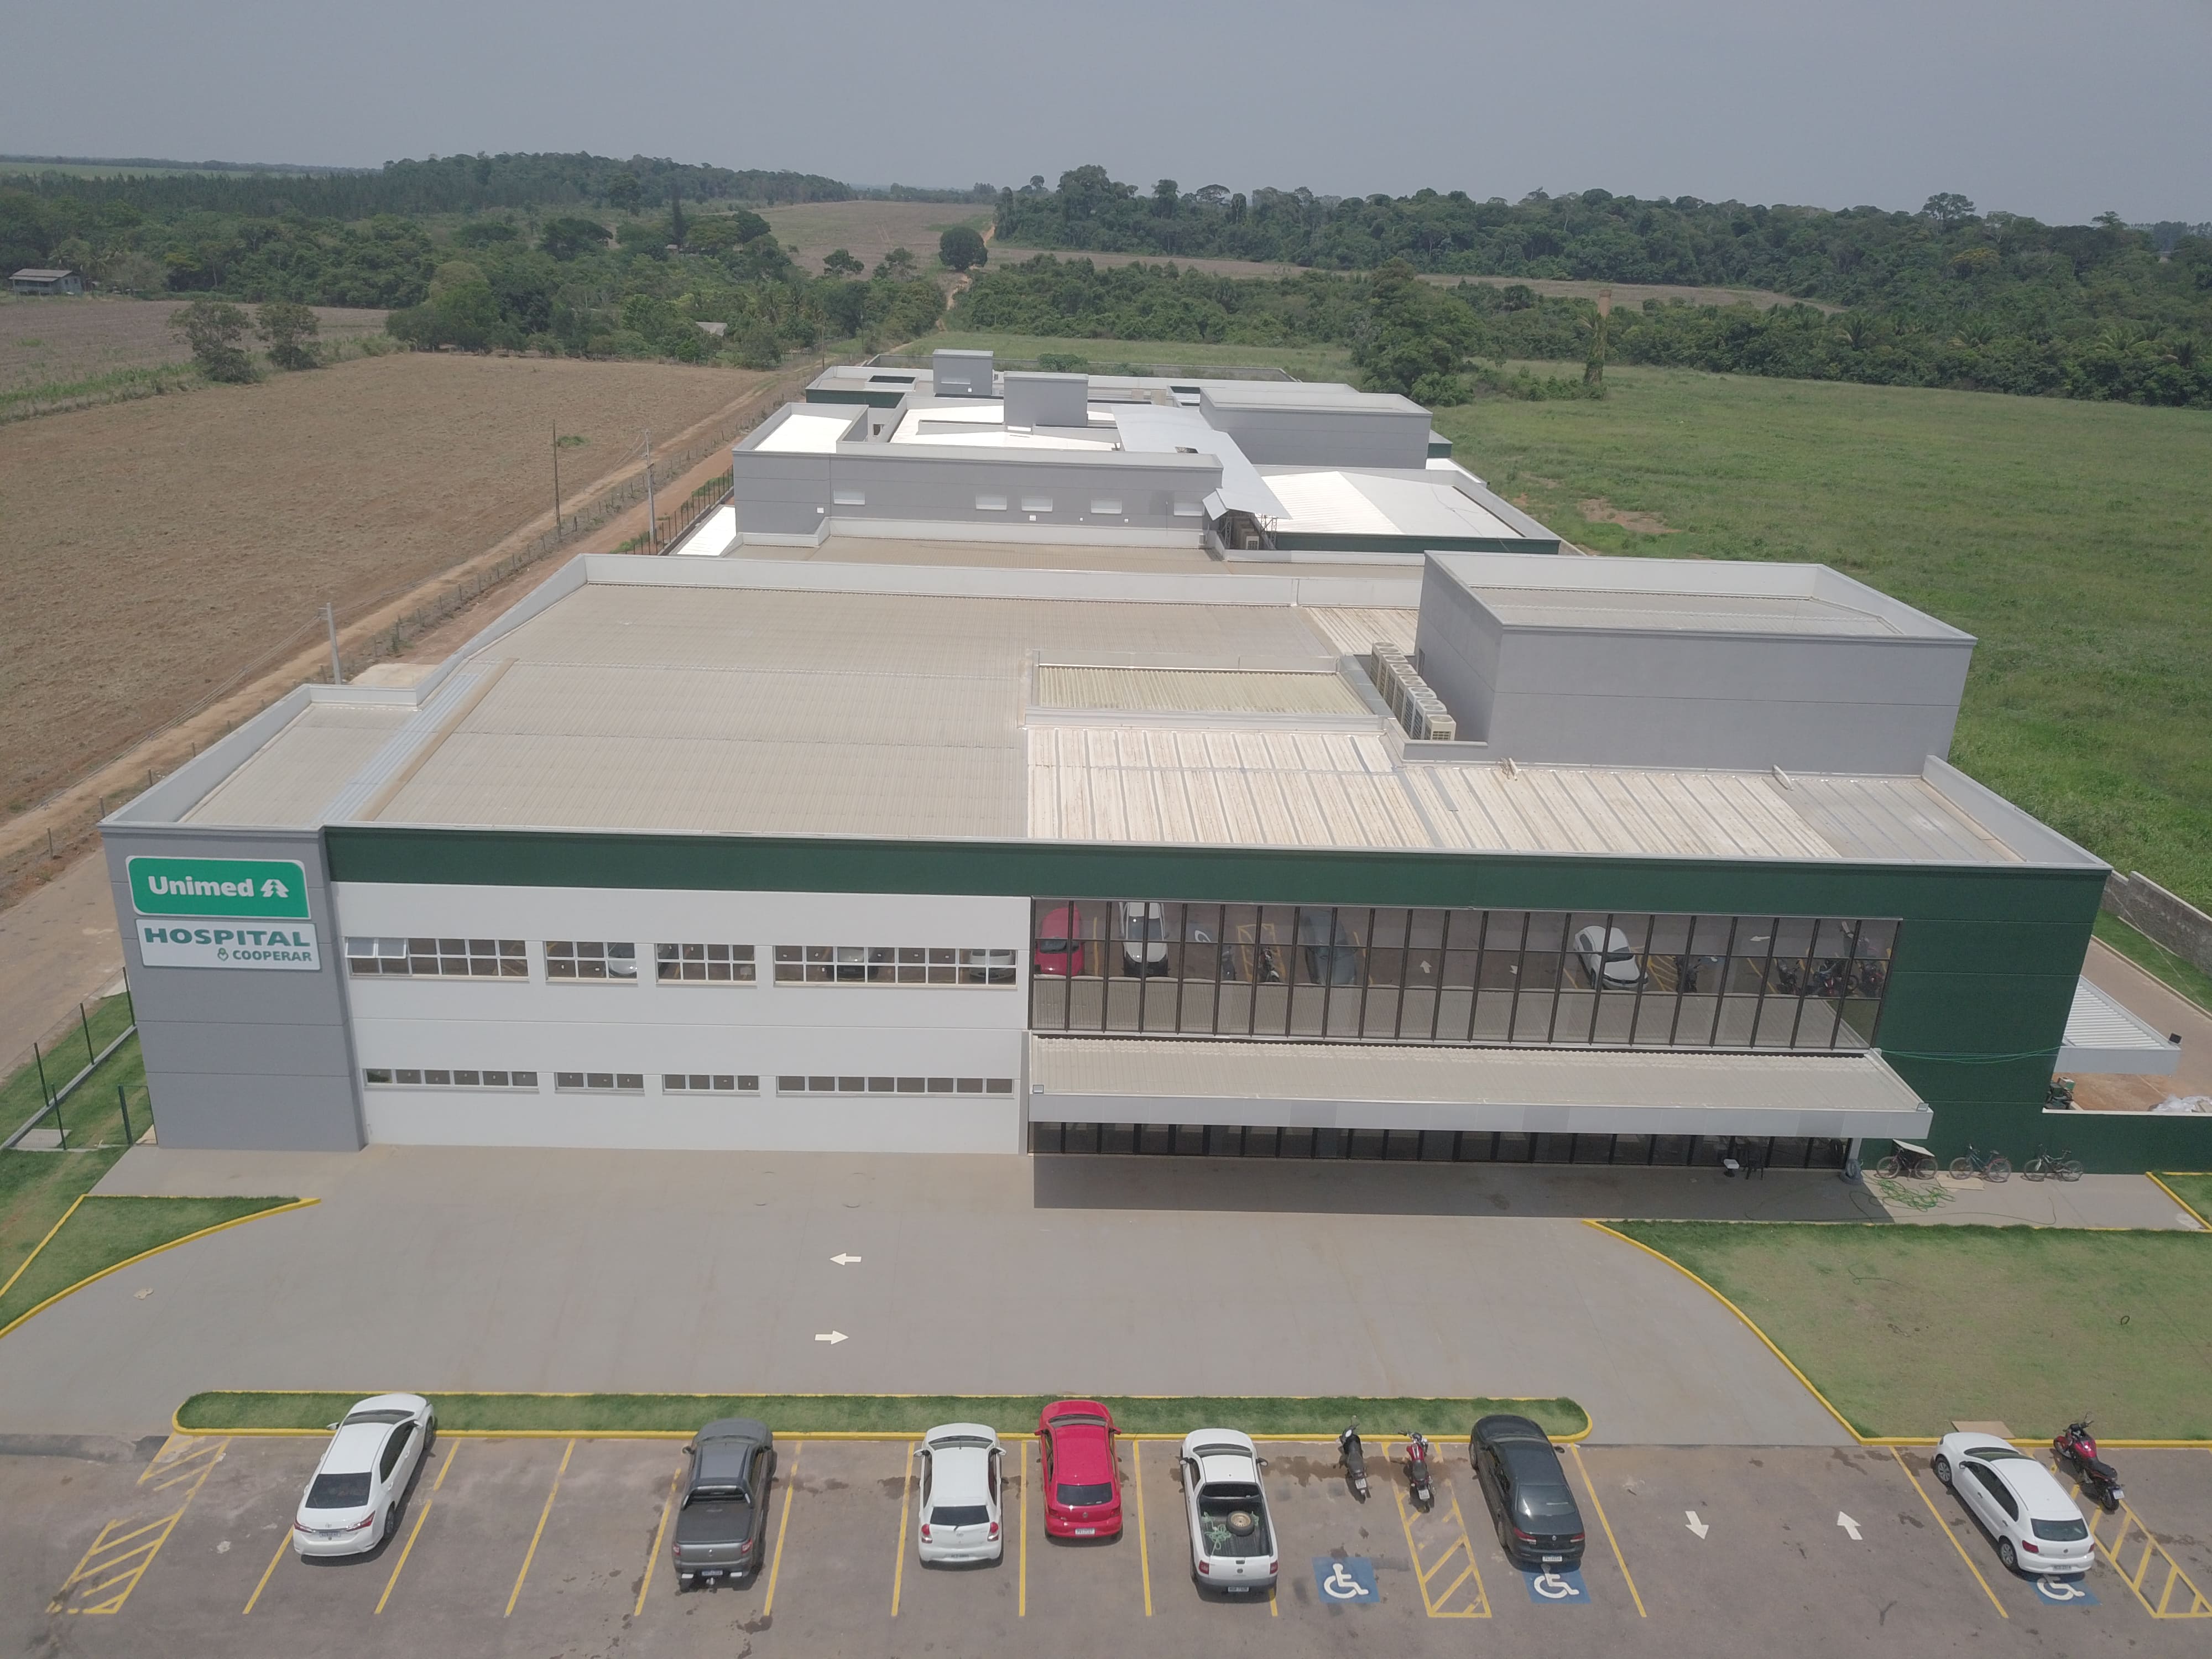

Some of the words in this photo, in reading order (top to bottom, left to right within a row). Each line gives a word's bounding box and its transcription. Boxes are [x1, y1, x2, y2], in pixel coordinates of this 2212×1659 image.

[148, 876, 254, 897] Unimed
[144, 928, 311, 947] HOSPITAL
[233, 950, 312, 962] COOPERAR
